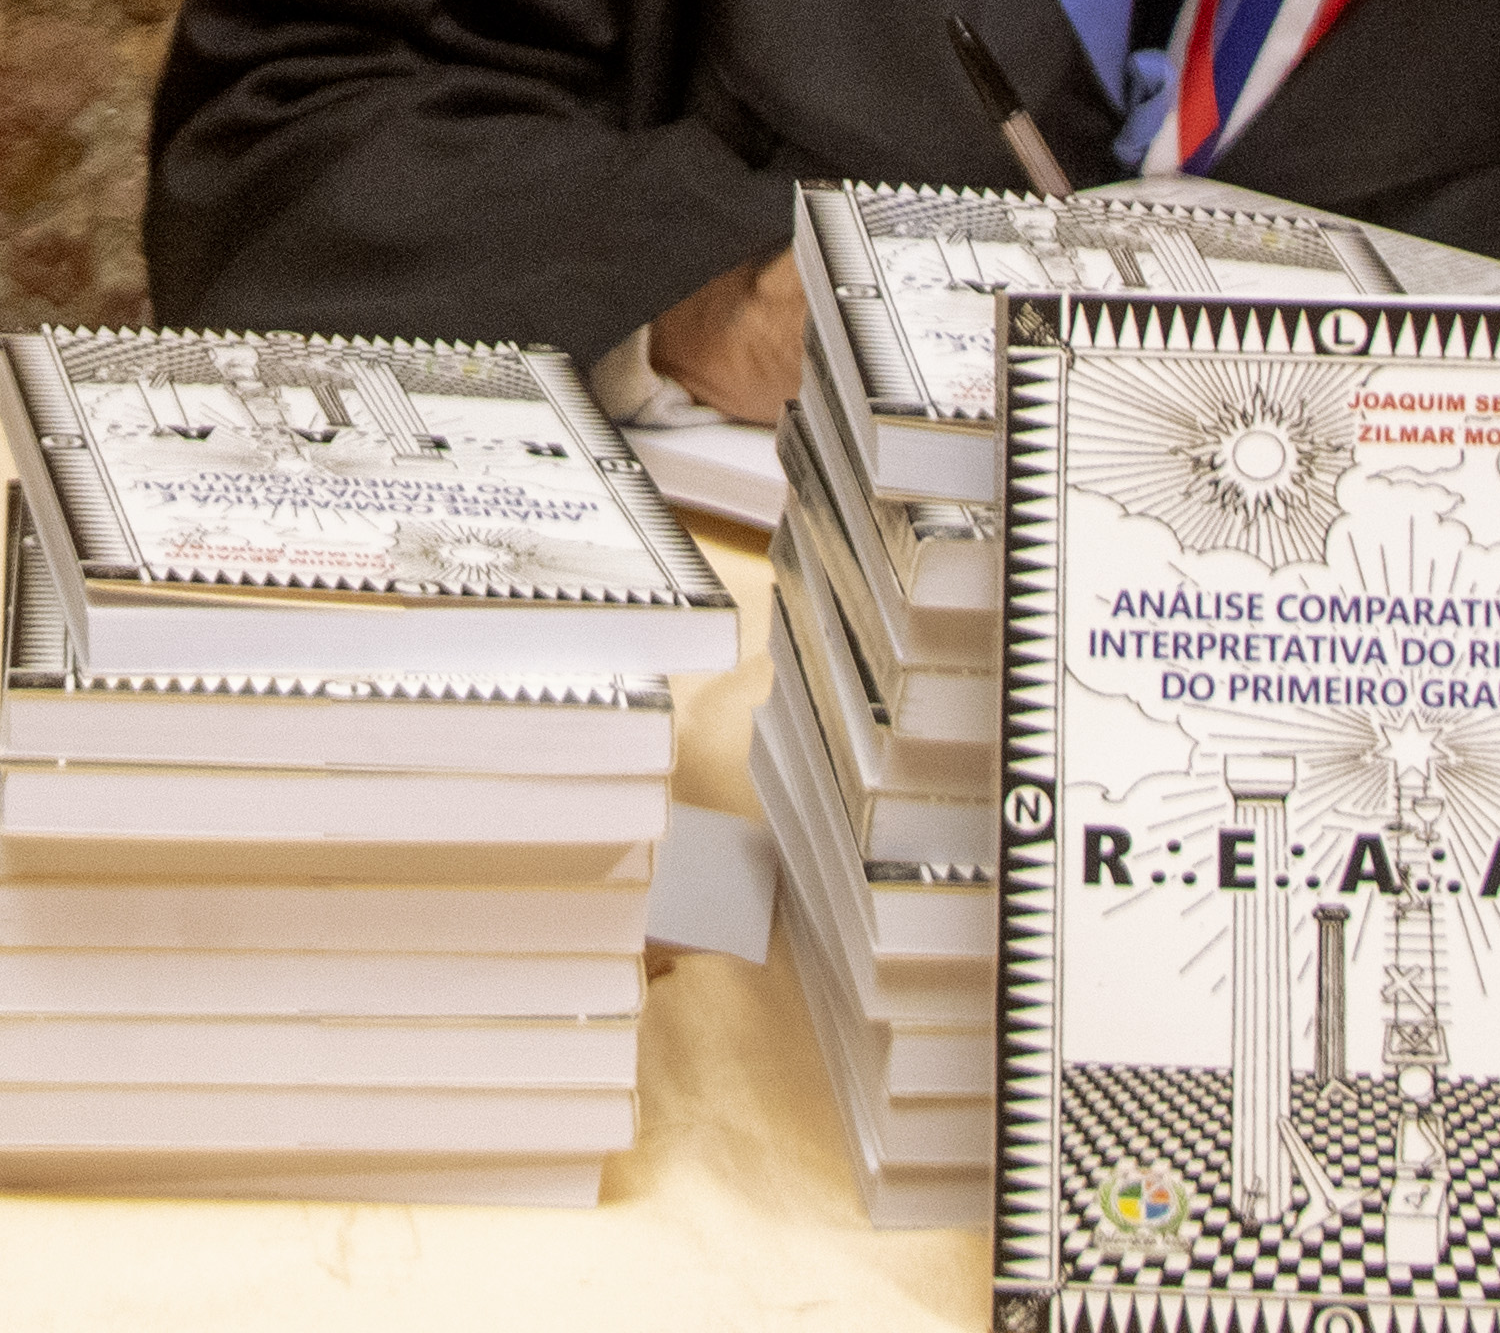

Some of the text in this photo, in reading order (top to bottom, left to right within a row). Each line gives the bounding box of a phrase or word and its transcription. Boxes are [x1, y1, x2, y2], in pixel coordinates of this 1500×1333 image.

[1348, 391, 1466, 412] JOAQUIM
[1357, 423, 1455, 444] ZILMAR
[1111, 582, 1265, 622] ANÁLISE
[1088, 628, 1388, 665] INTERPRETATIVA
[1401, 637, 1456, 668] DO
[1161, 671, 1215, 702] DO
[1228, 673, 1408, 707] PRIMEIRO
